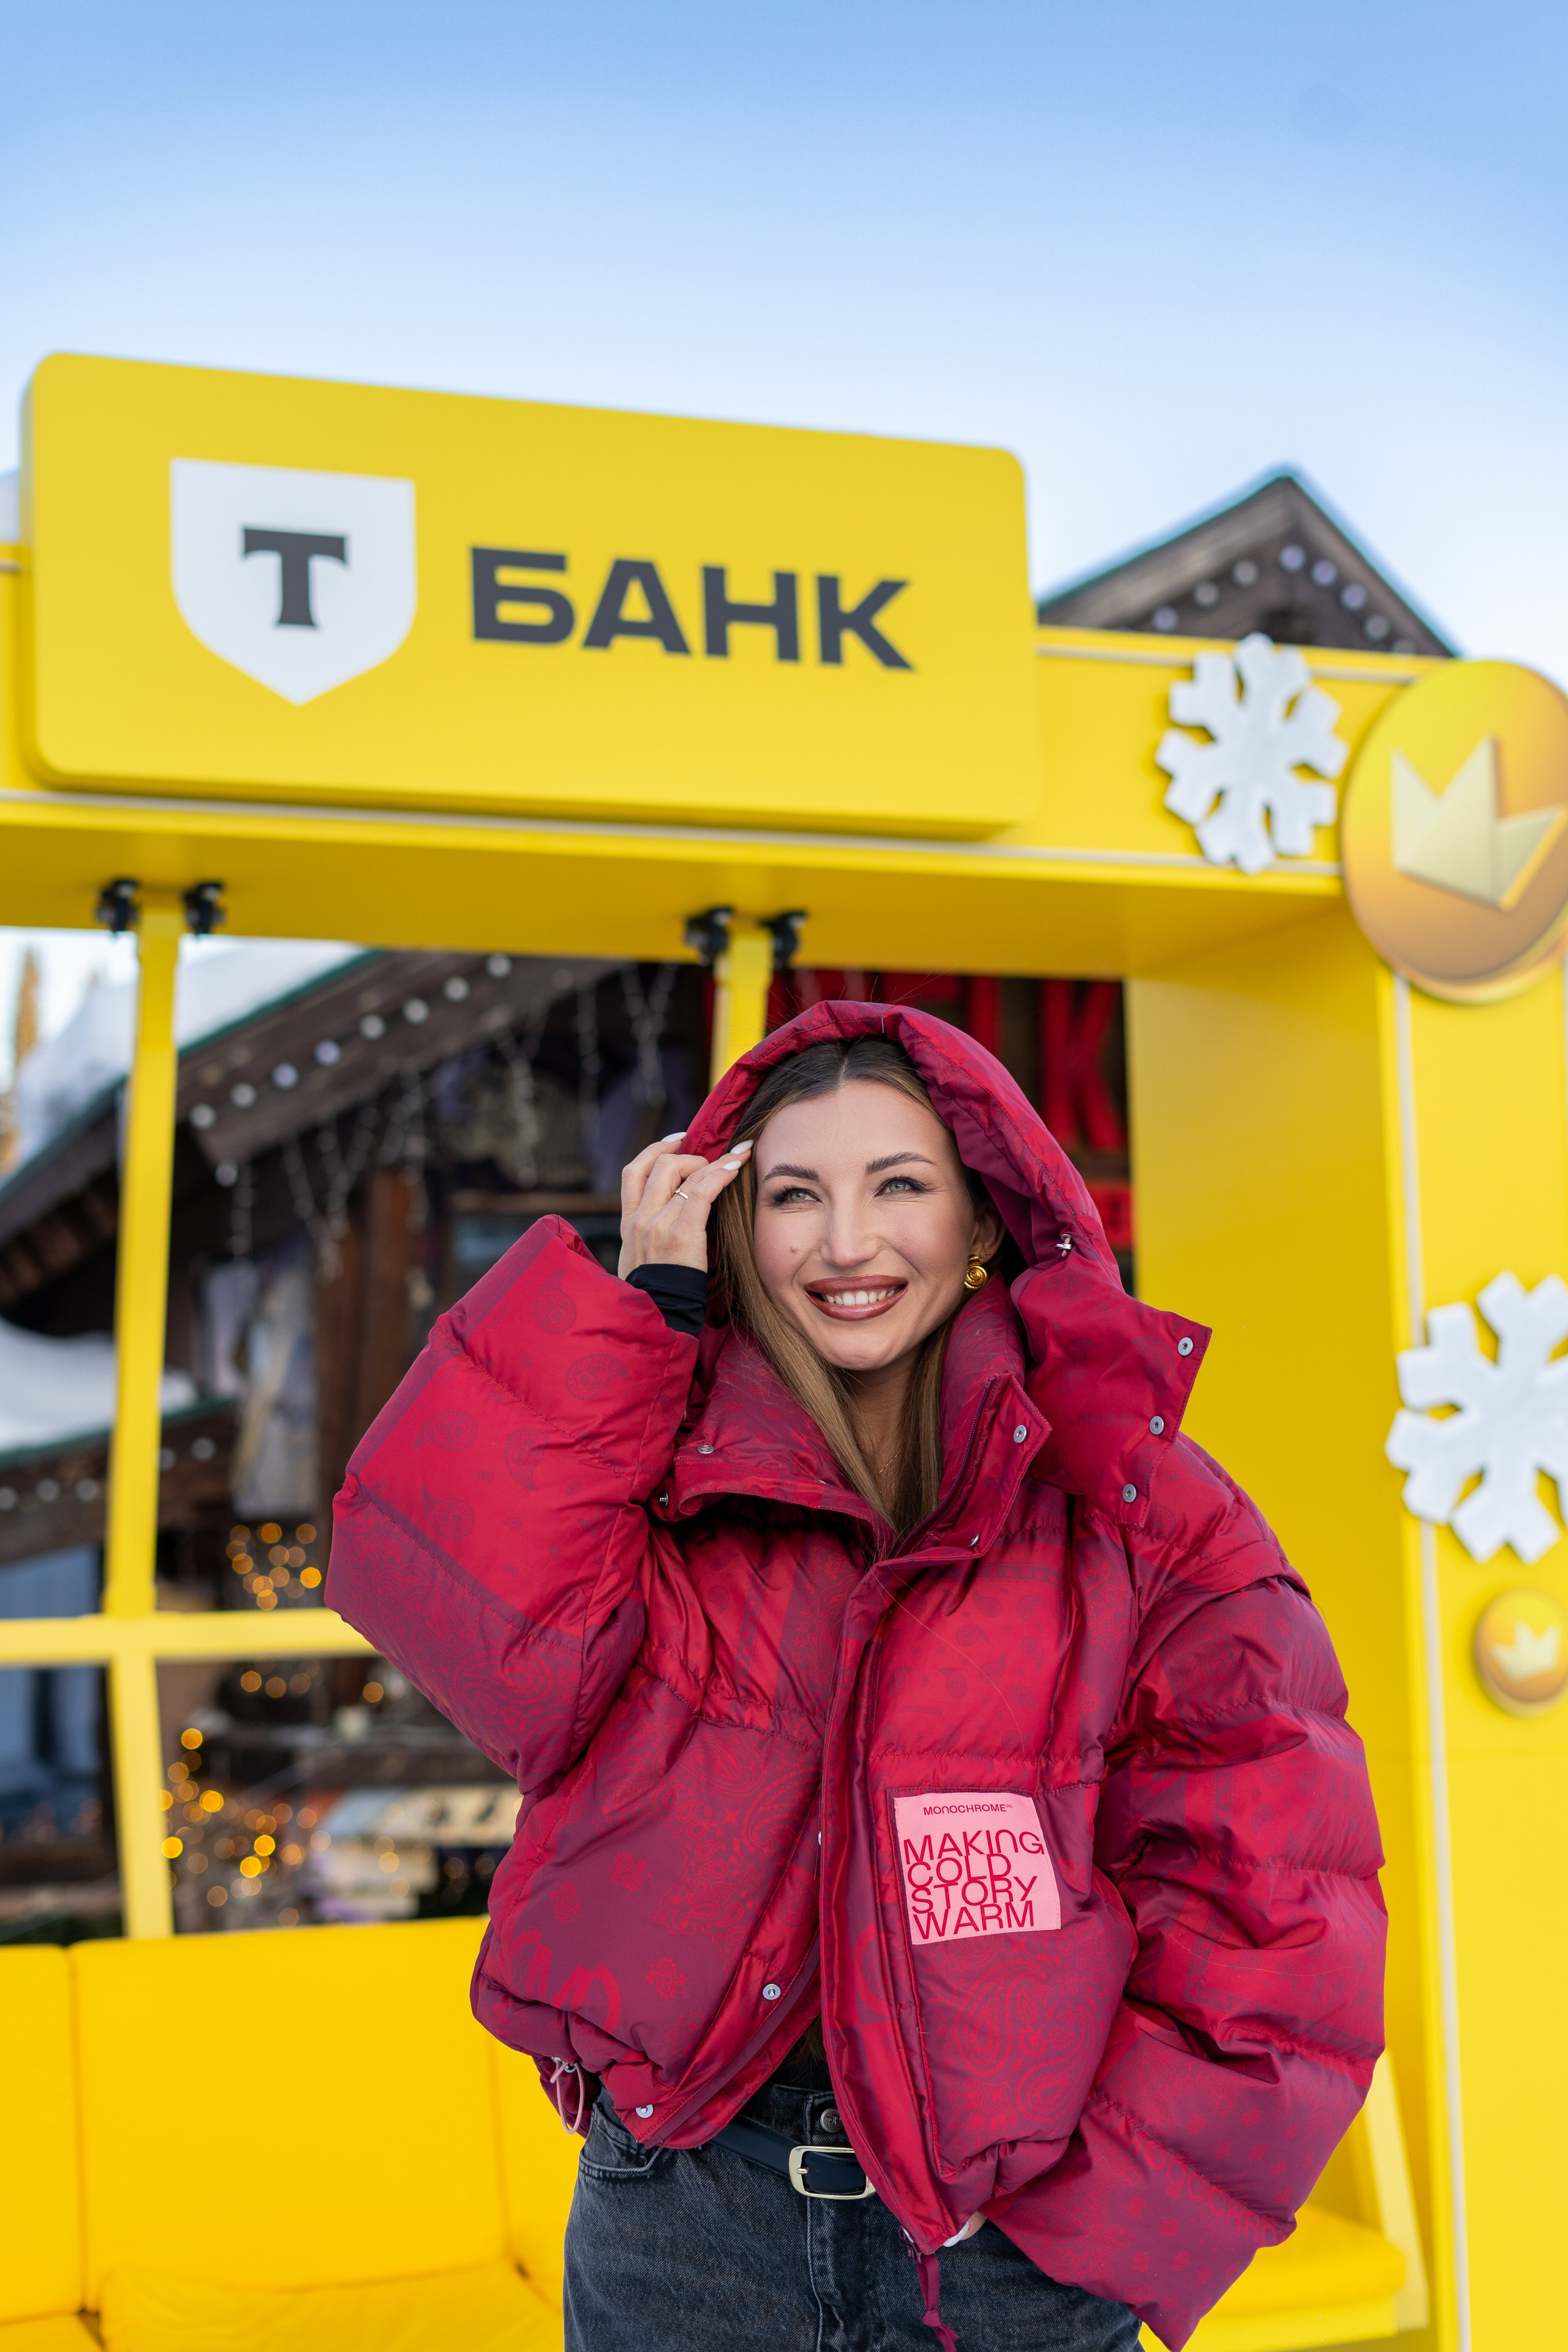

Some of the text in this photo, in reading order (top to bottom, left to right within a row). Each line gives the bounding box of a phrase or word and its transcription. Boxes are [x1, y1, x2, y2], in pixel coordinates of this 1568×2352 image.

[242, 526, 915, 673] Т БАНК
[903, 1829, 1045, 1865] MAKING
[907, 1853, 1011, 1888] COLD
[911, 1875, 1038, 1914] STORY
[913, 1900, 1035, 1940] WARM
